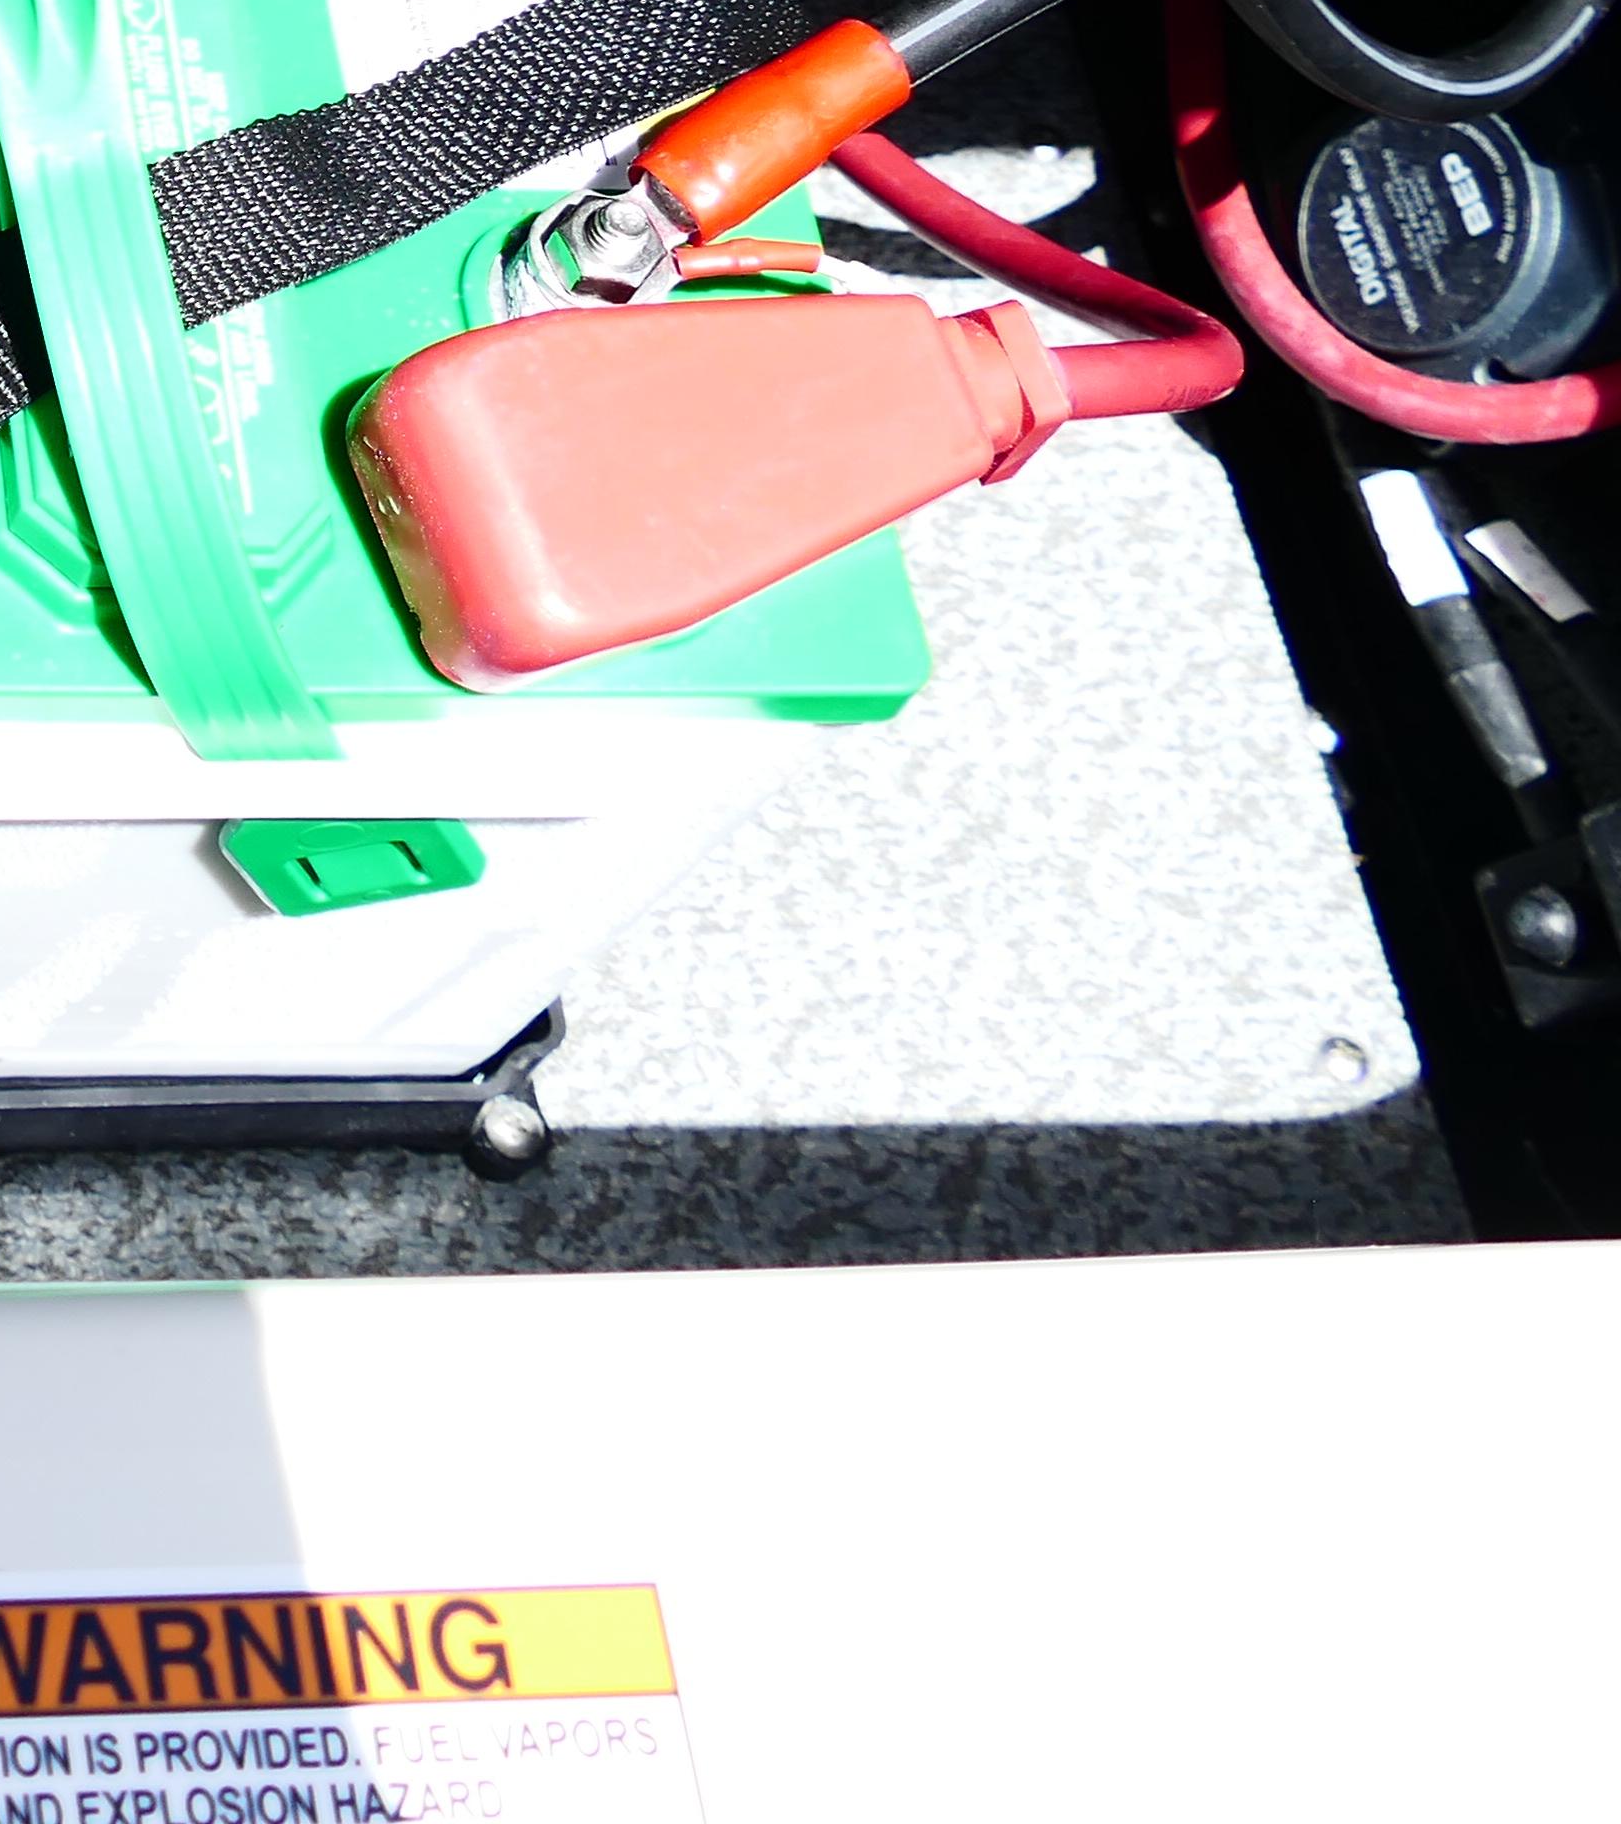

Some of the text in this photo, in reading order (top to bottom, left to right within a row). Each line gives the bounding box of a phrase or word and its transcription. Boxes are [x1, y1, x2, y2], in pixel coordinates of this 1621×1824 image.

[1440, 152, 1493, 237] BEP
[1330, 195, 1387, 305] DIGITAL
[85, 1731, 123, 1776] IS
[134, 1726, 362, 1774] PROVIDED.
[372, 1725, 478, 1766] FUEL
[497, 1717, 658, 1759] VAPORS
[75, 1785, 317, 1824] EXPLOSION
[331, 1781, 502, 1823] HAZARD
